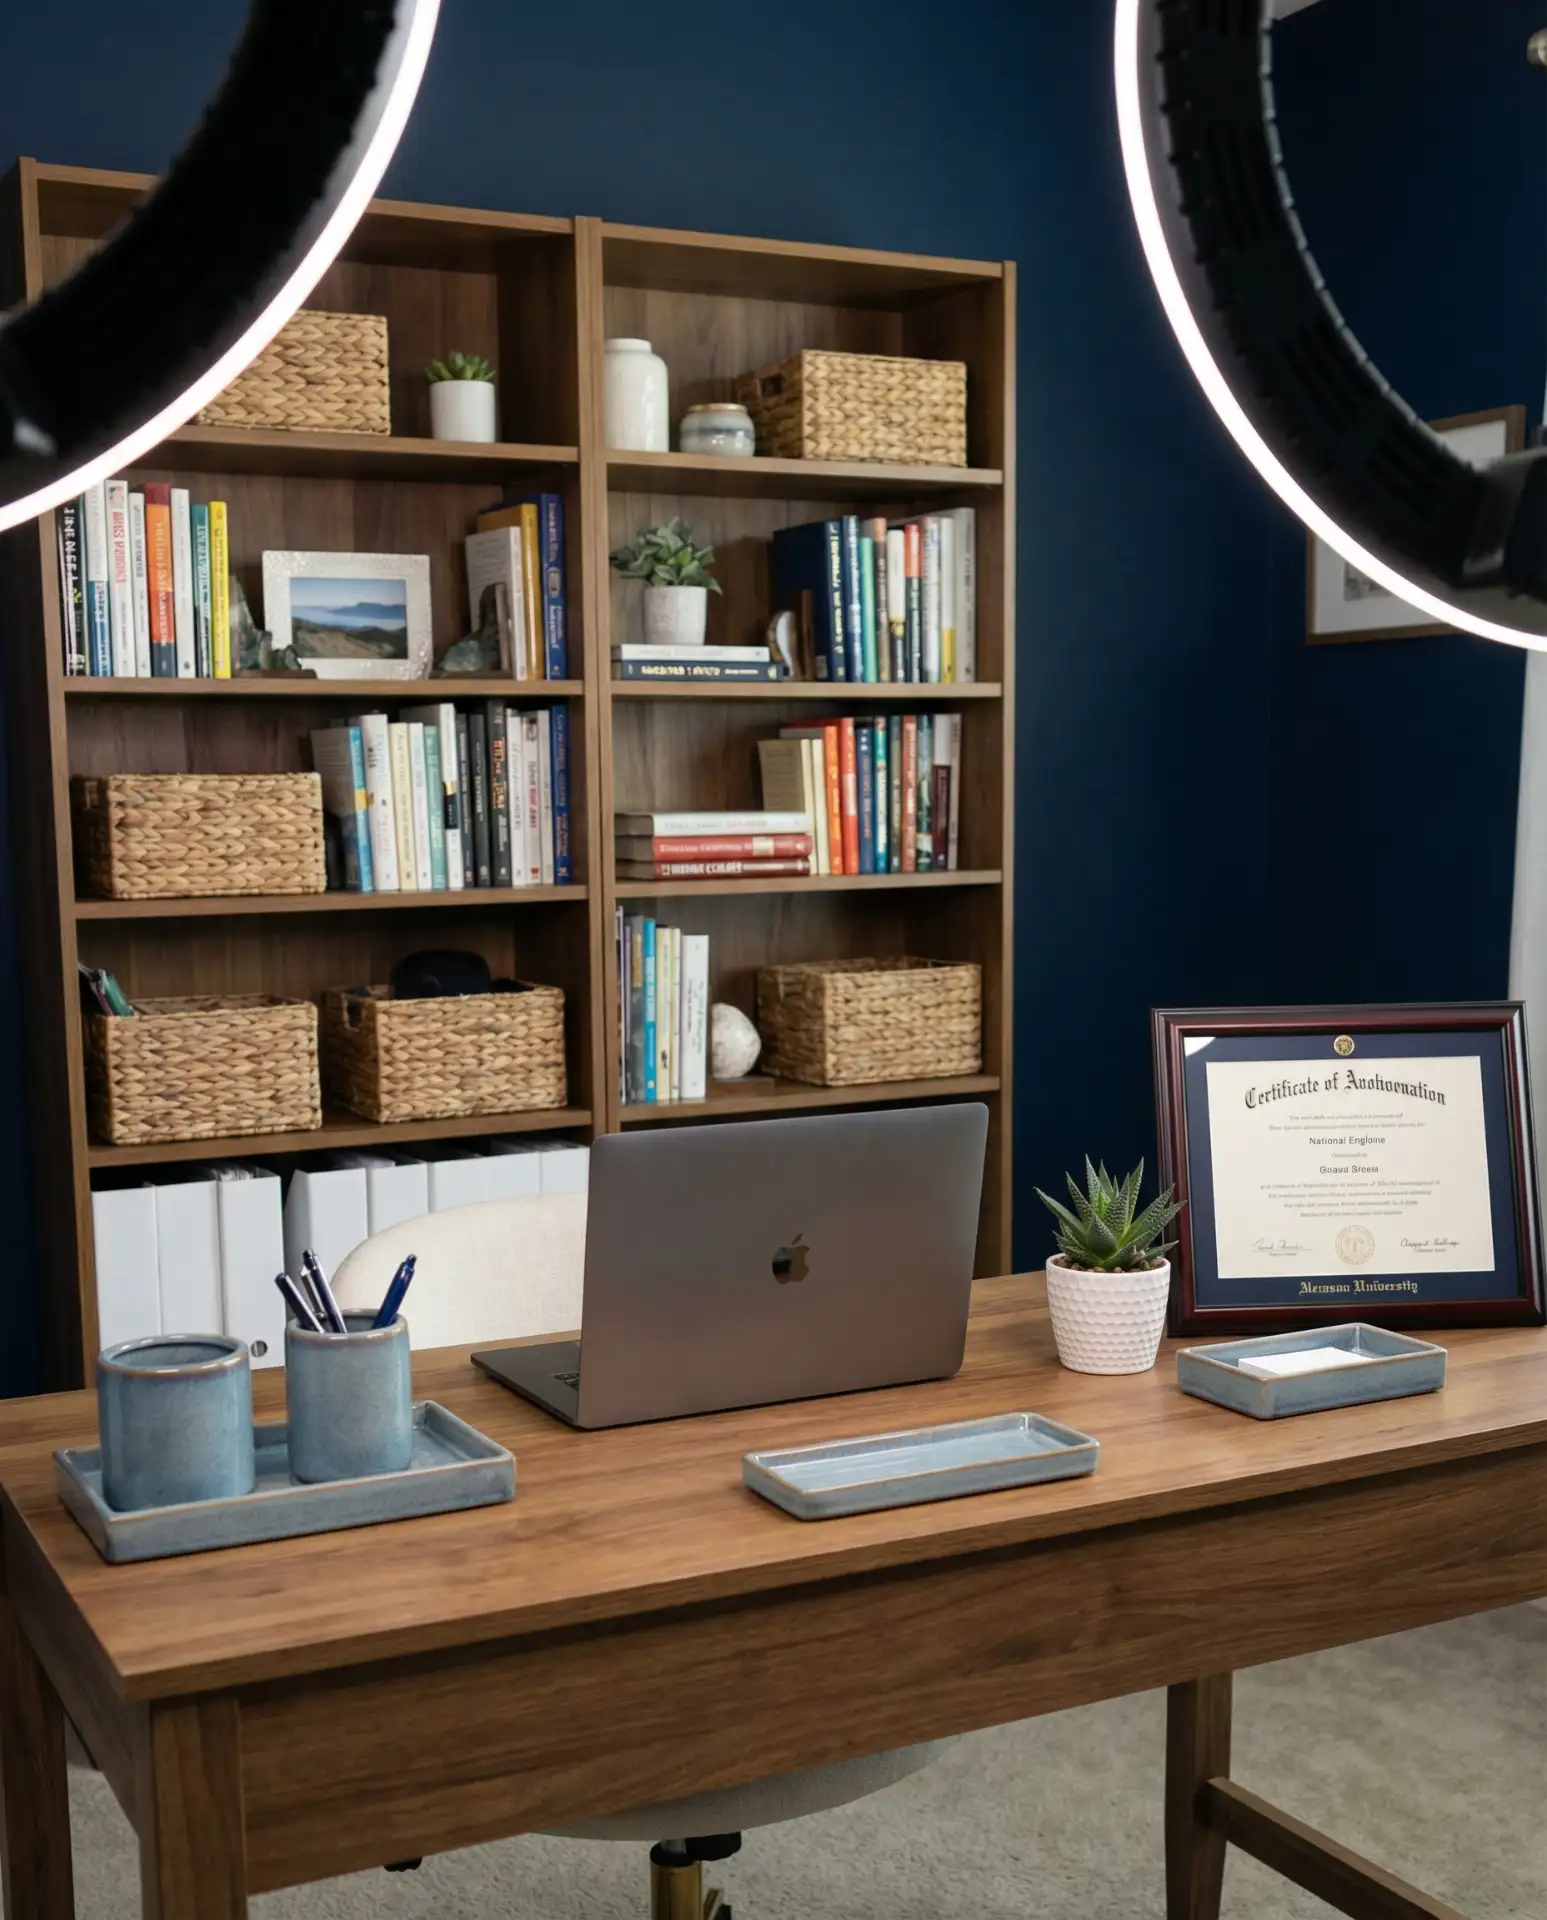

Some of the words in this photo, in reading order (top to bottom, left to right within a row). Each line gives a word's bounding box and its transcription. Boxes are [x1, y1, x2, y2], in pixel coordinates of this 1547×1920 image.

[1244, 1076, 1319, 1109] Certificate
[1324, 1072, 1339, 1091] of
[1309, 1137, 1346, 1145] National
